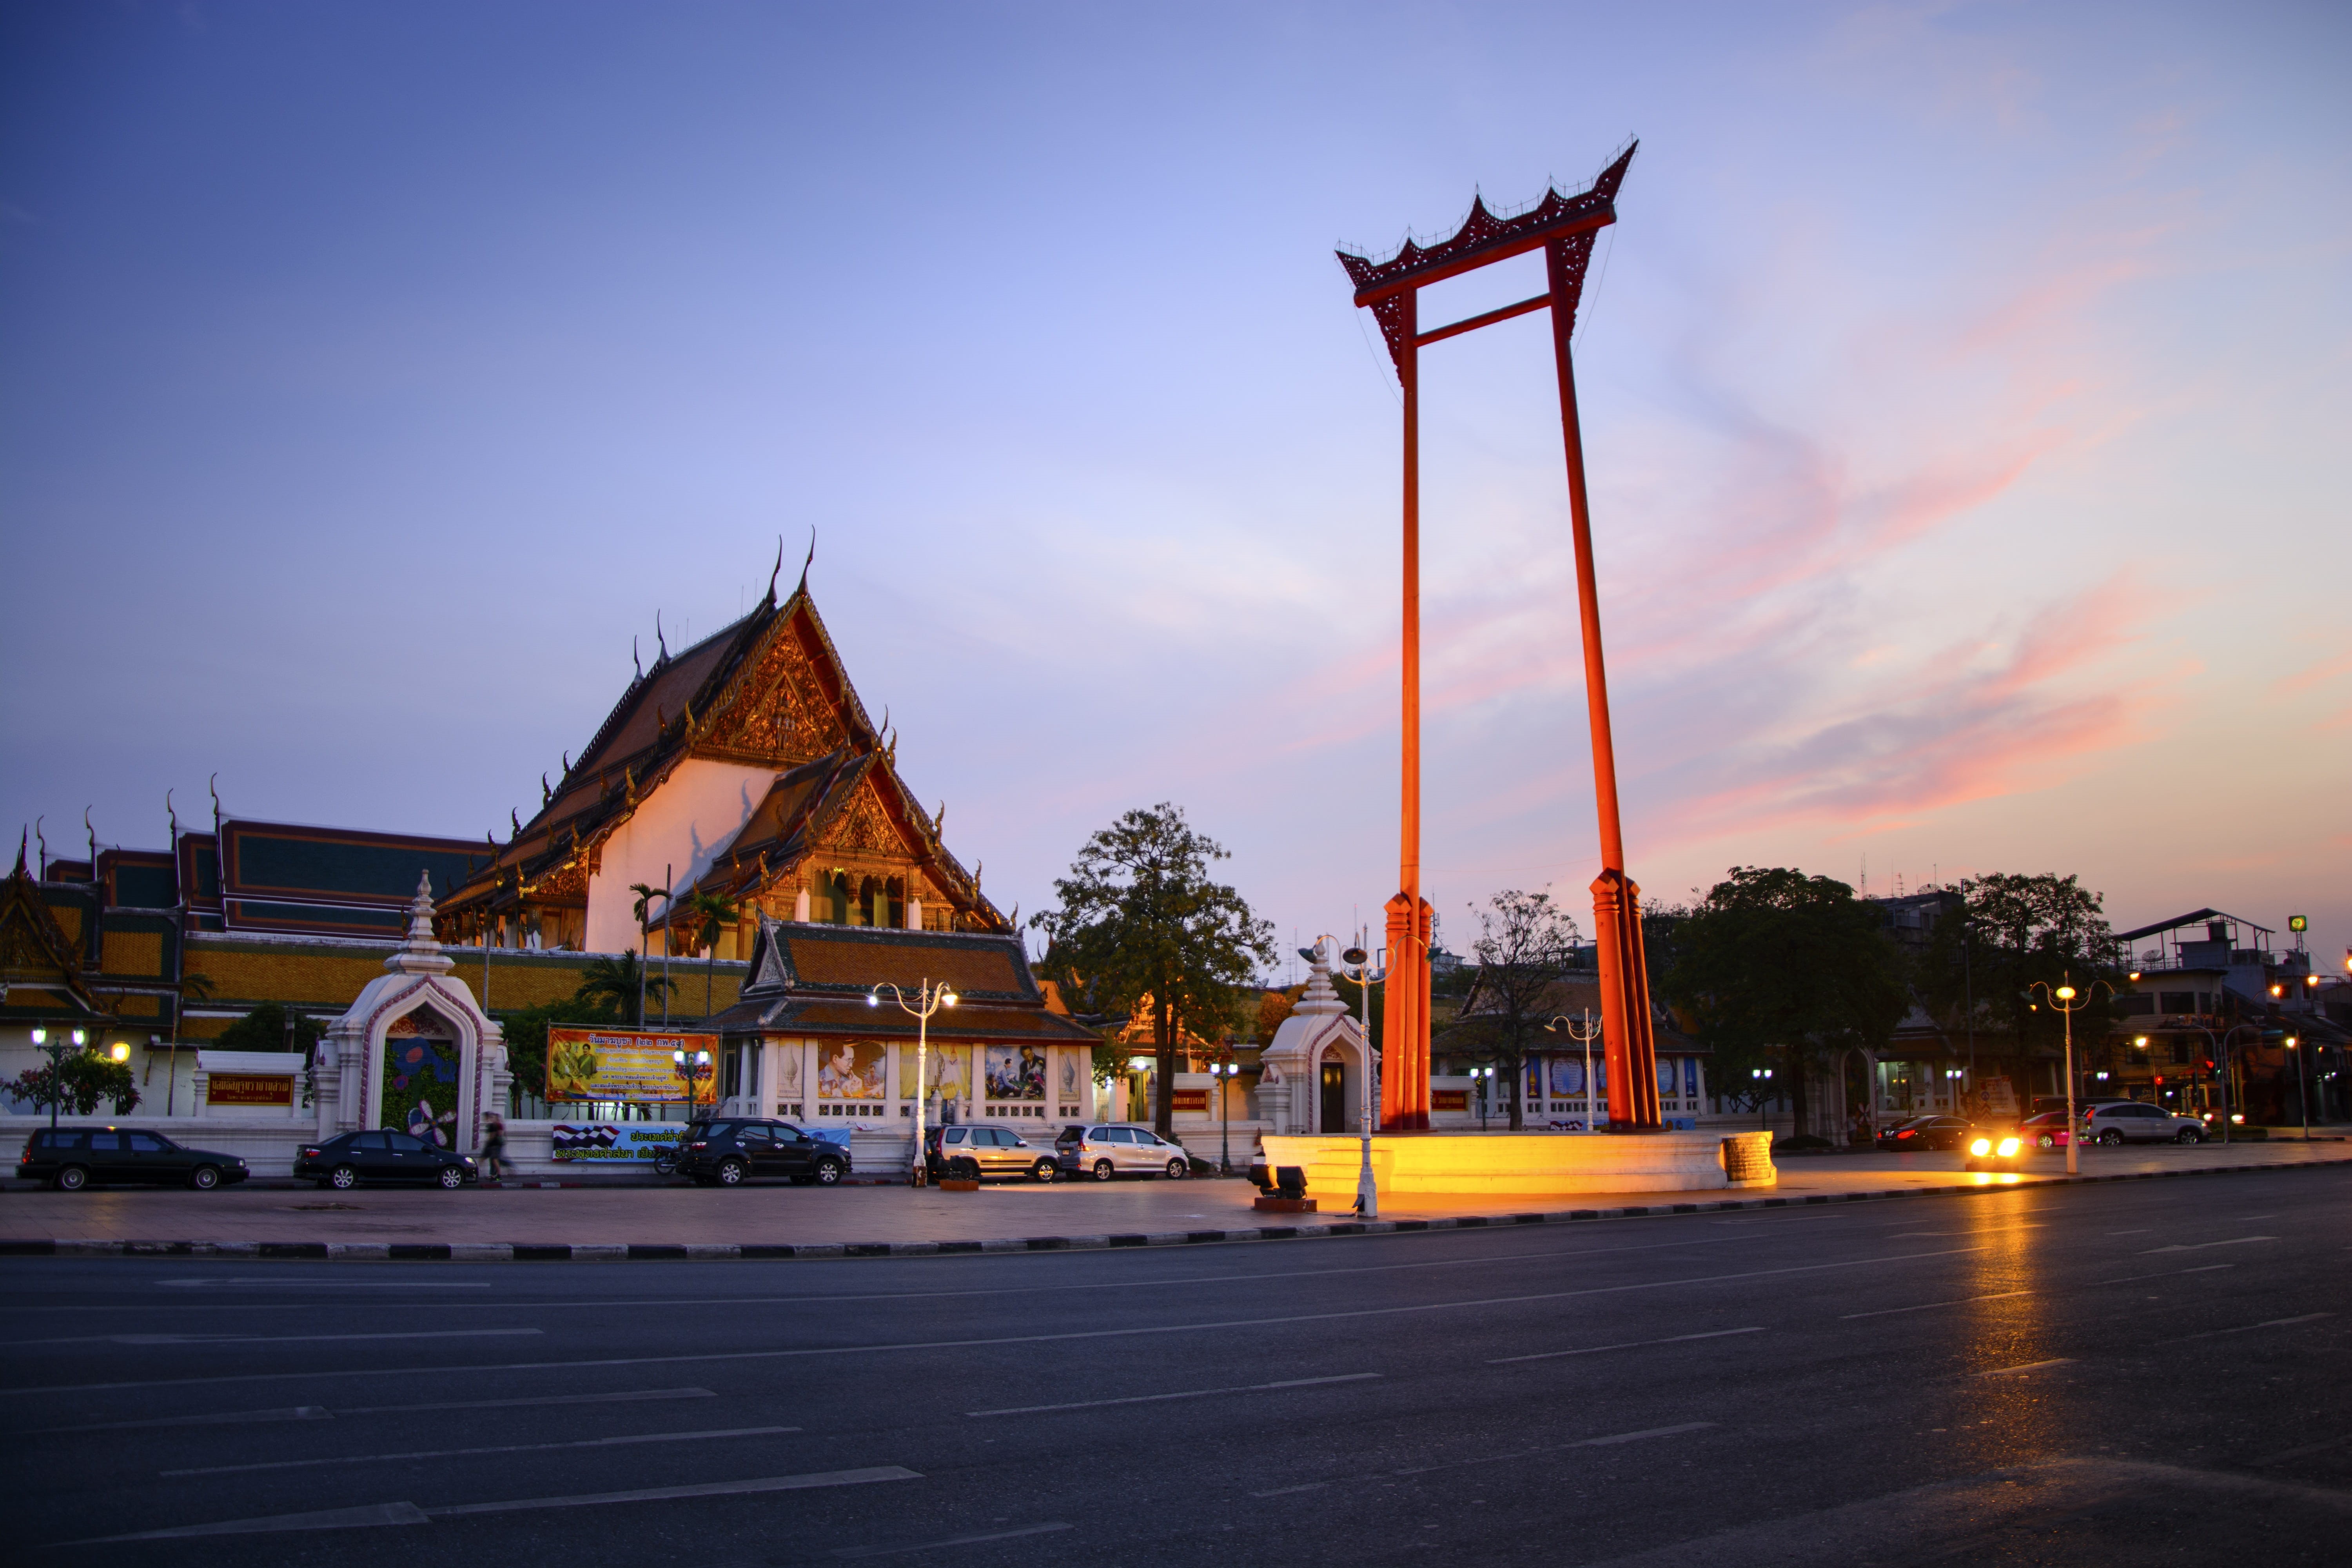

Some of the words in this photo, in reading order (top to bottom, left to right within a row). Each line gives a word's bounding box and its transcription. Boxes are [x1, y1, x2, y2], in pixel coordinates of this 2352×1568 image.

[588, 1034, 632, 1047] วันมาฆบูชา
[636, 1037, 652, 1046] (๒๒
[556, 1146, 633, 1160] พระพุทธศาสนา
